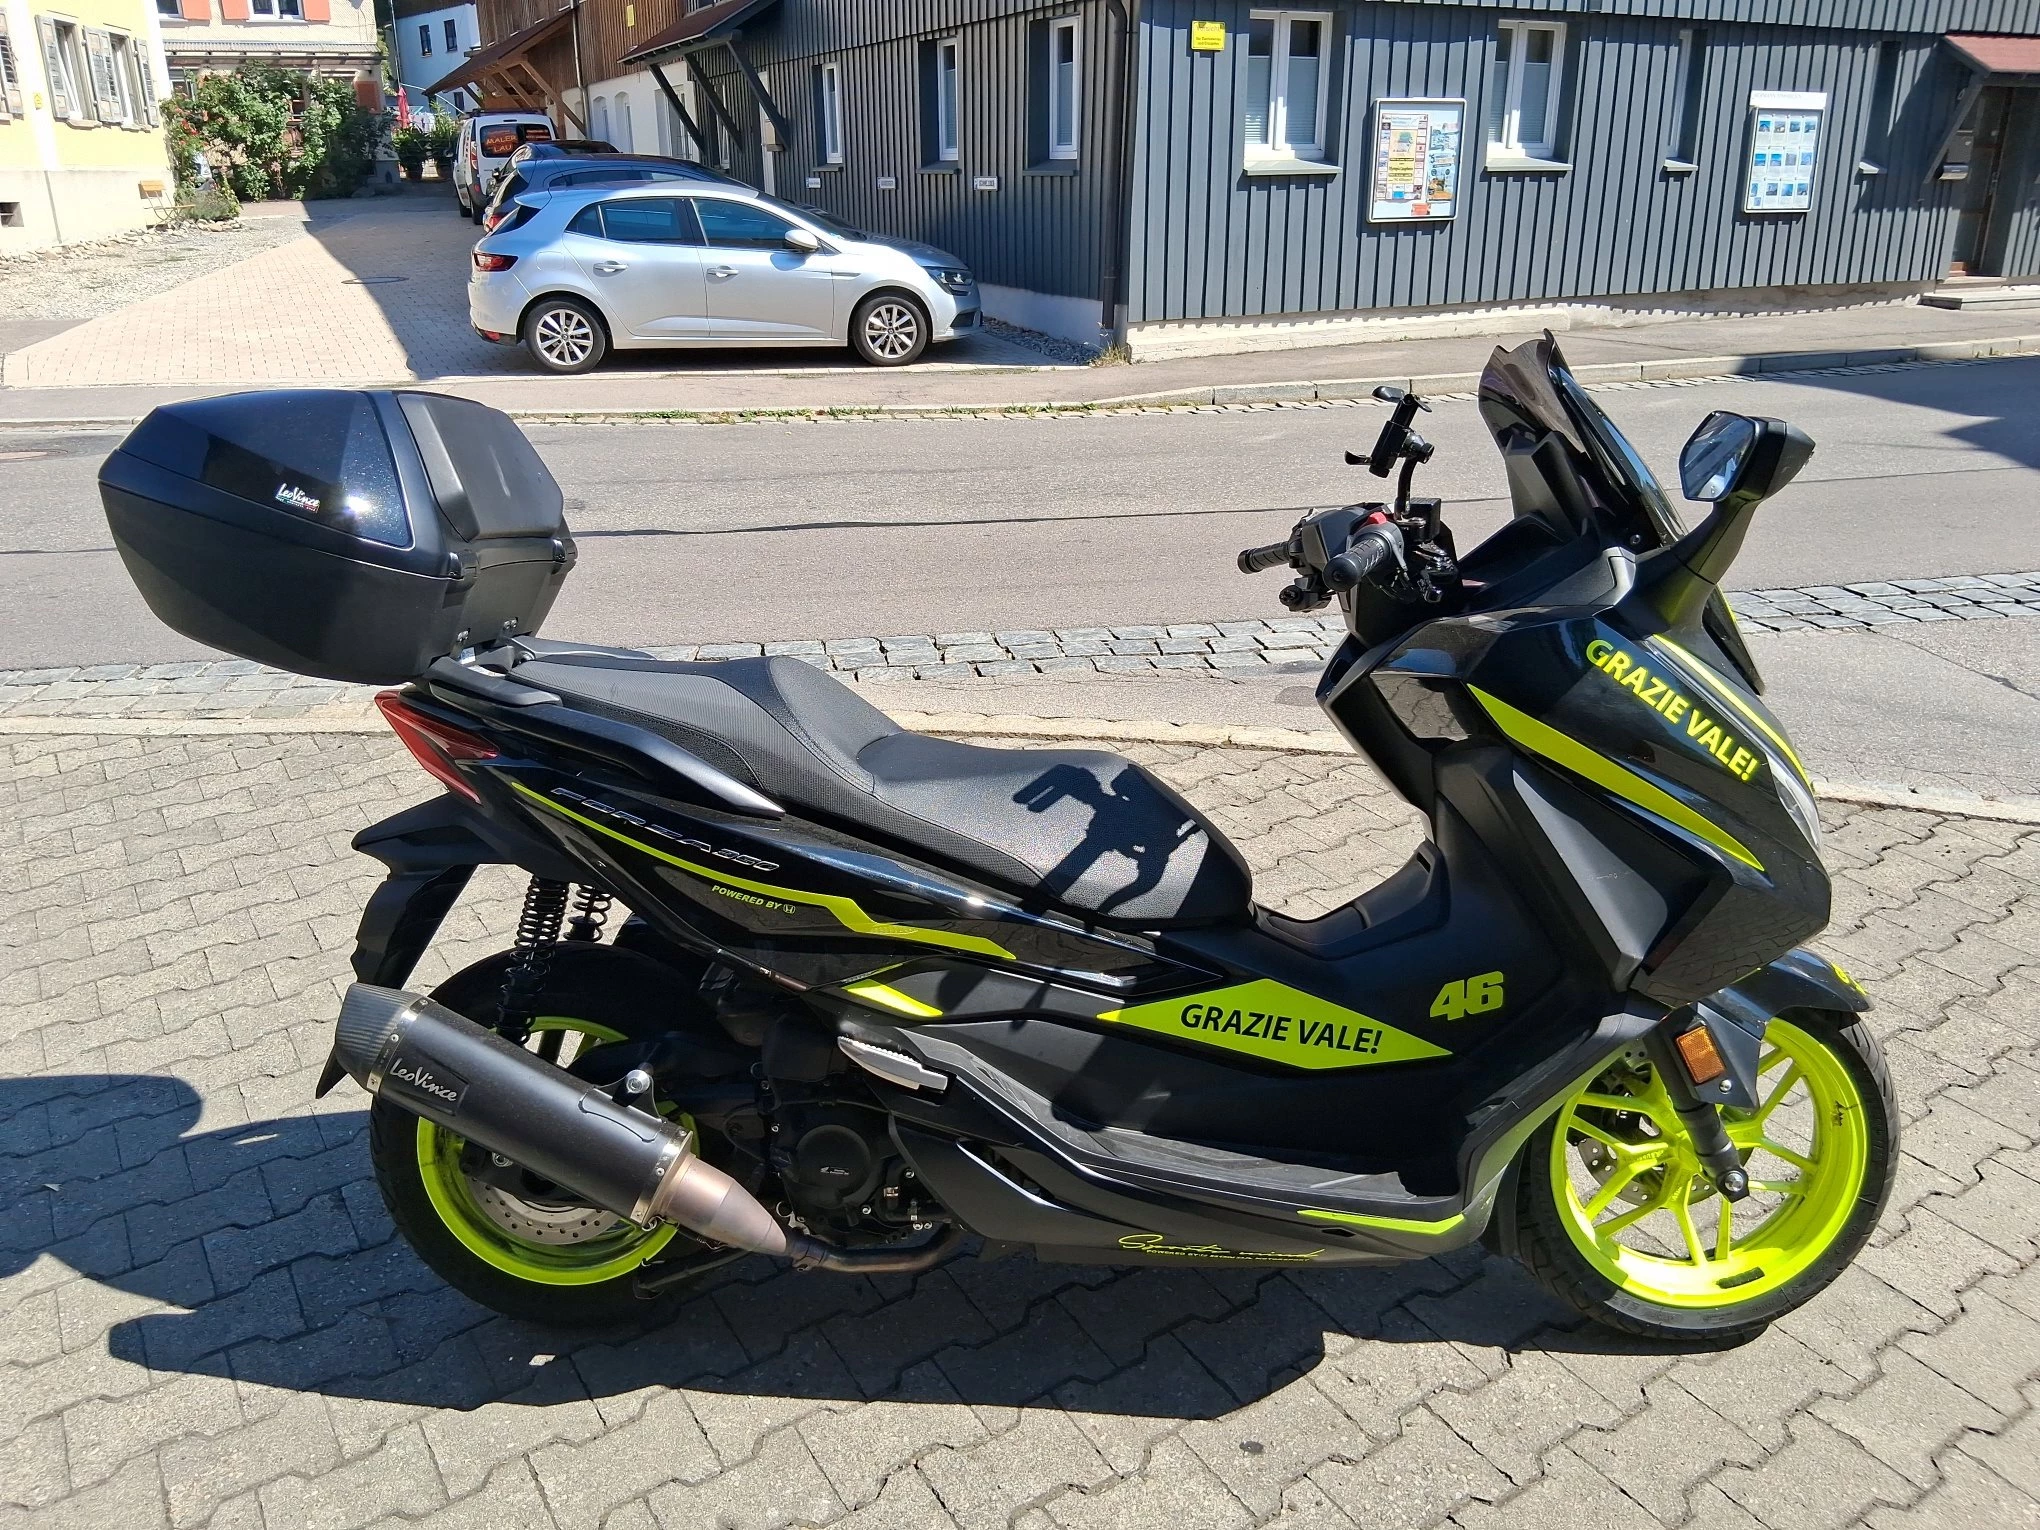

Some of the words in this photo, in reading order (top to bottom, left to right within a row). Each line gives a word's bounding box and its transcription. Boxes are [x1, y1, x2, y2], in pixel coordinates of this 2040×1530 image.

[487, 135, 517, 145] MALER
[493, 144, 512, 152] LAU
[276, 483, 320, 507] LeoVince
[1586, 639, 1690, 724] GRAZIE
[1686, 709, 1759, 781] VALE!
[551, 787, 712, 853] FORZA
[711, 848, 780, 872] 350
[711, 885, 764, 905] POWERED
[765, 900, 782, 910] BY
[1429, 970, 1504, 1021] 46
[1180, 1003, 1291, 1042] GRAZIE
[1298, 1019, 1383, 1055] VALE!
[389, 1058, 457, 1101] LeoVince
